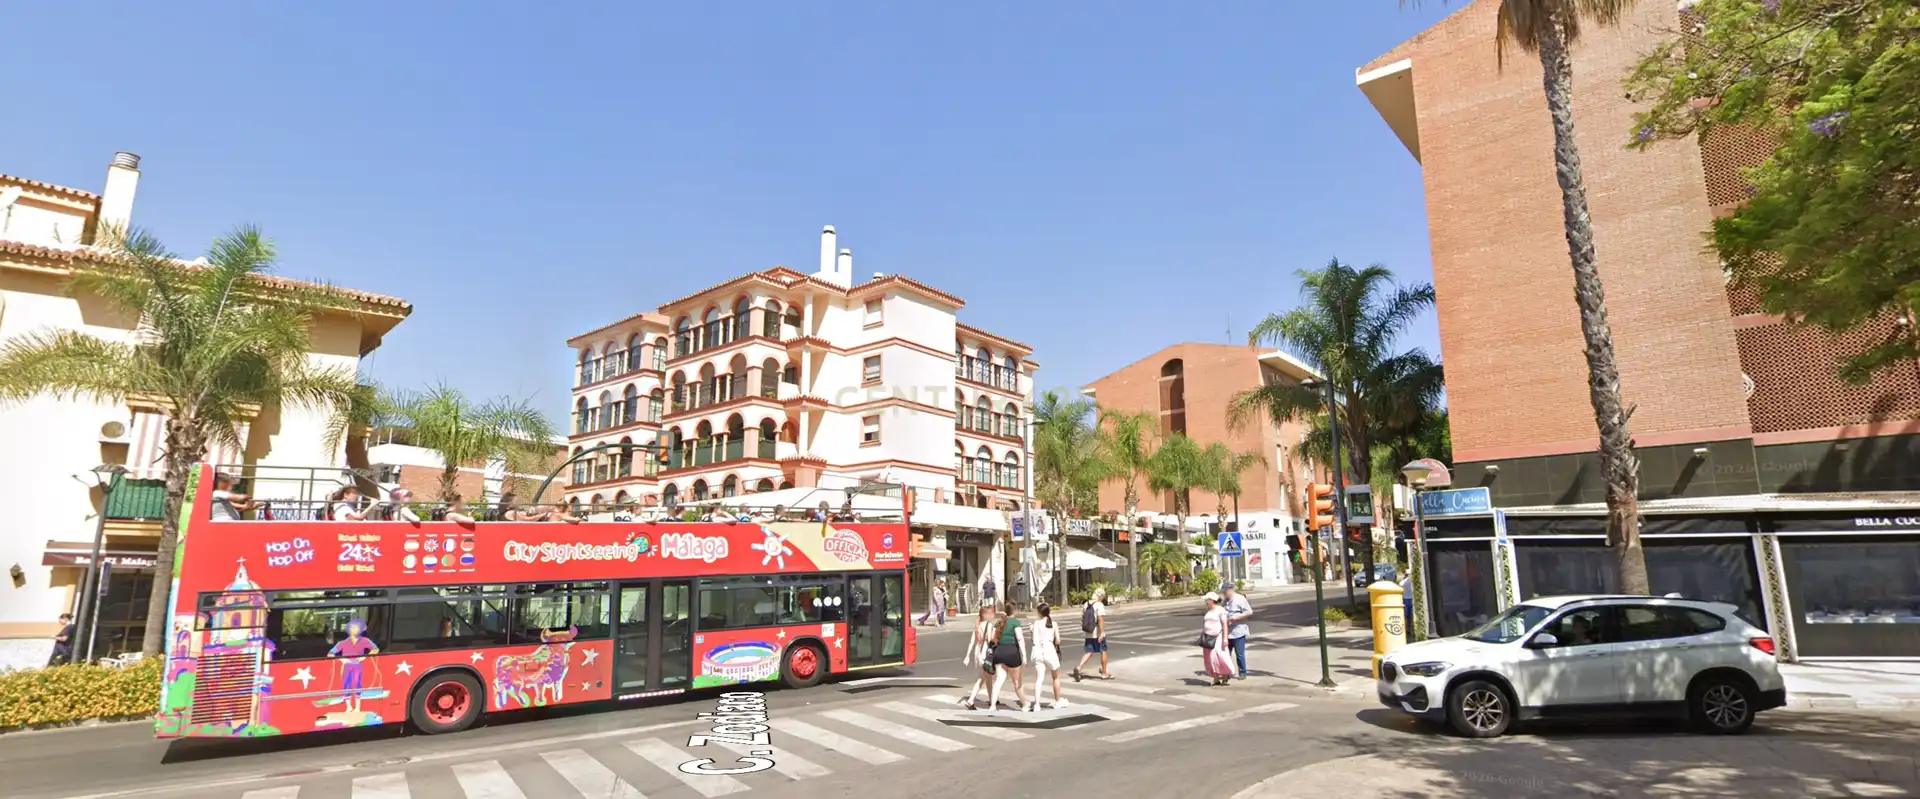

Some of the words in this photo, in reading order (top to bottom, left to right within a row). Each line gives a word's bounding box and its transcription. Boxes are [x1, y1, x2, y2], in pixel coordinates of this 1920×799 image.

[1855, 517, 1890, 526] BELLA
[266, 541, 291, 552] Hop
[293, 537, 311, 549] On
[338, 543, 362, 561] 24
[660, 532, 729, 563] Málaga
[825, 539, 869, 559] OFFICIAL
[268, 555, 293, 567] Hop
[295, 549, 315, 562] Off
